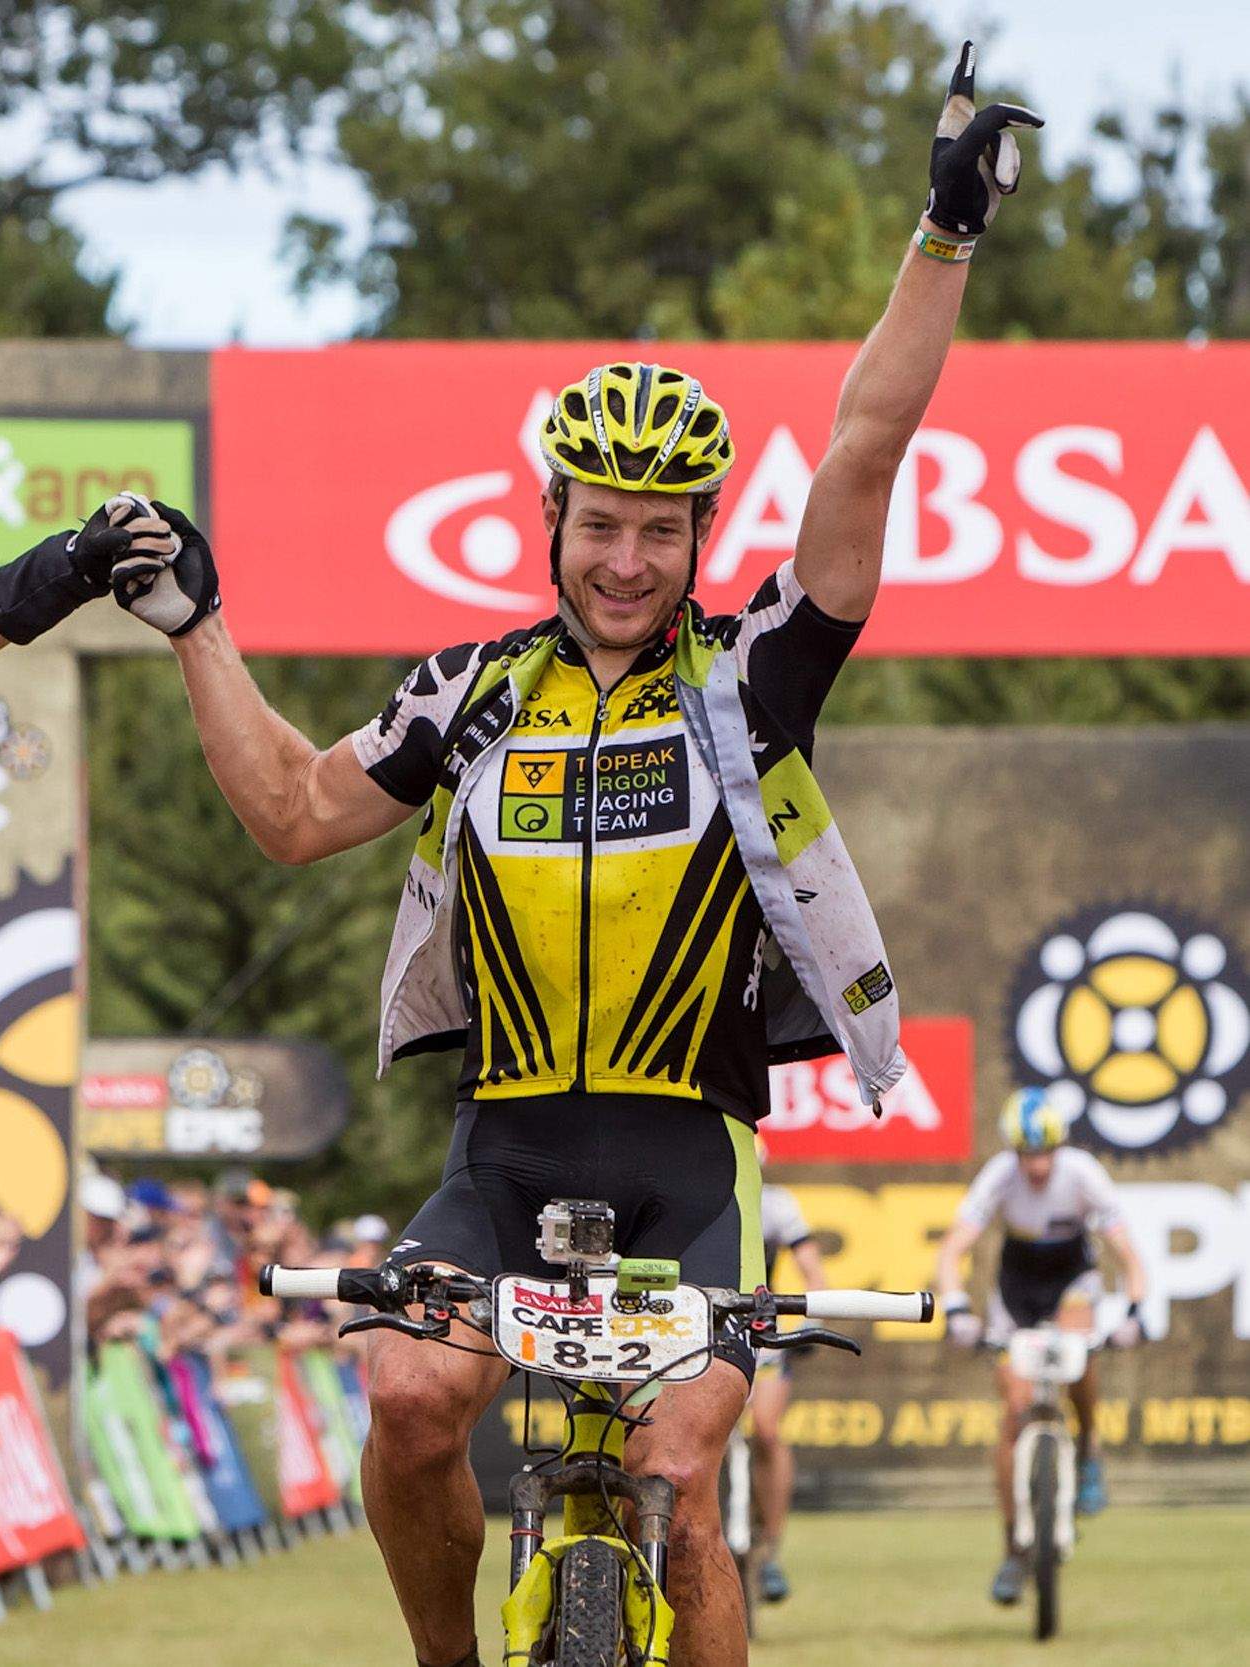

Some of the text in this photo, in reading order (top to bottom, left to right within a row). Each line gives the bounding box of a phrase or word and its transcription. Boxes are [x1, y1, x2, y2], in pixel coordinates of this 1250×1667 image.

[515, 709, 572, 728] BSA
[576, 747, 676, 773] TOPEAK
[575, 769, 667, 793] ERGON
[573, 811, 648, 833] TEAM
[512, 1307, 693, 1338] CAPE EPIC
[553, 1341, 651, 1371] 8-2
